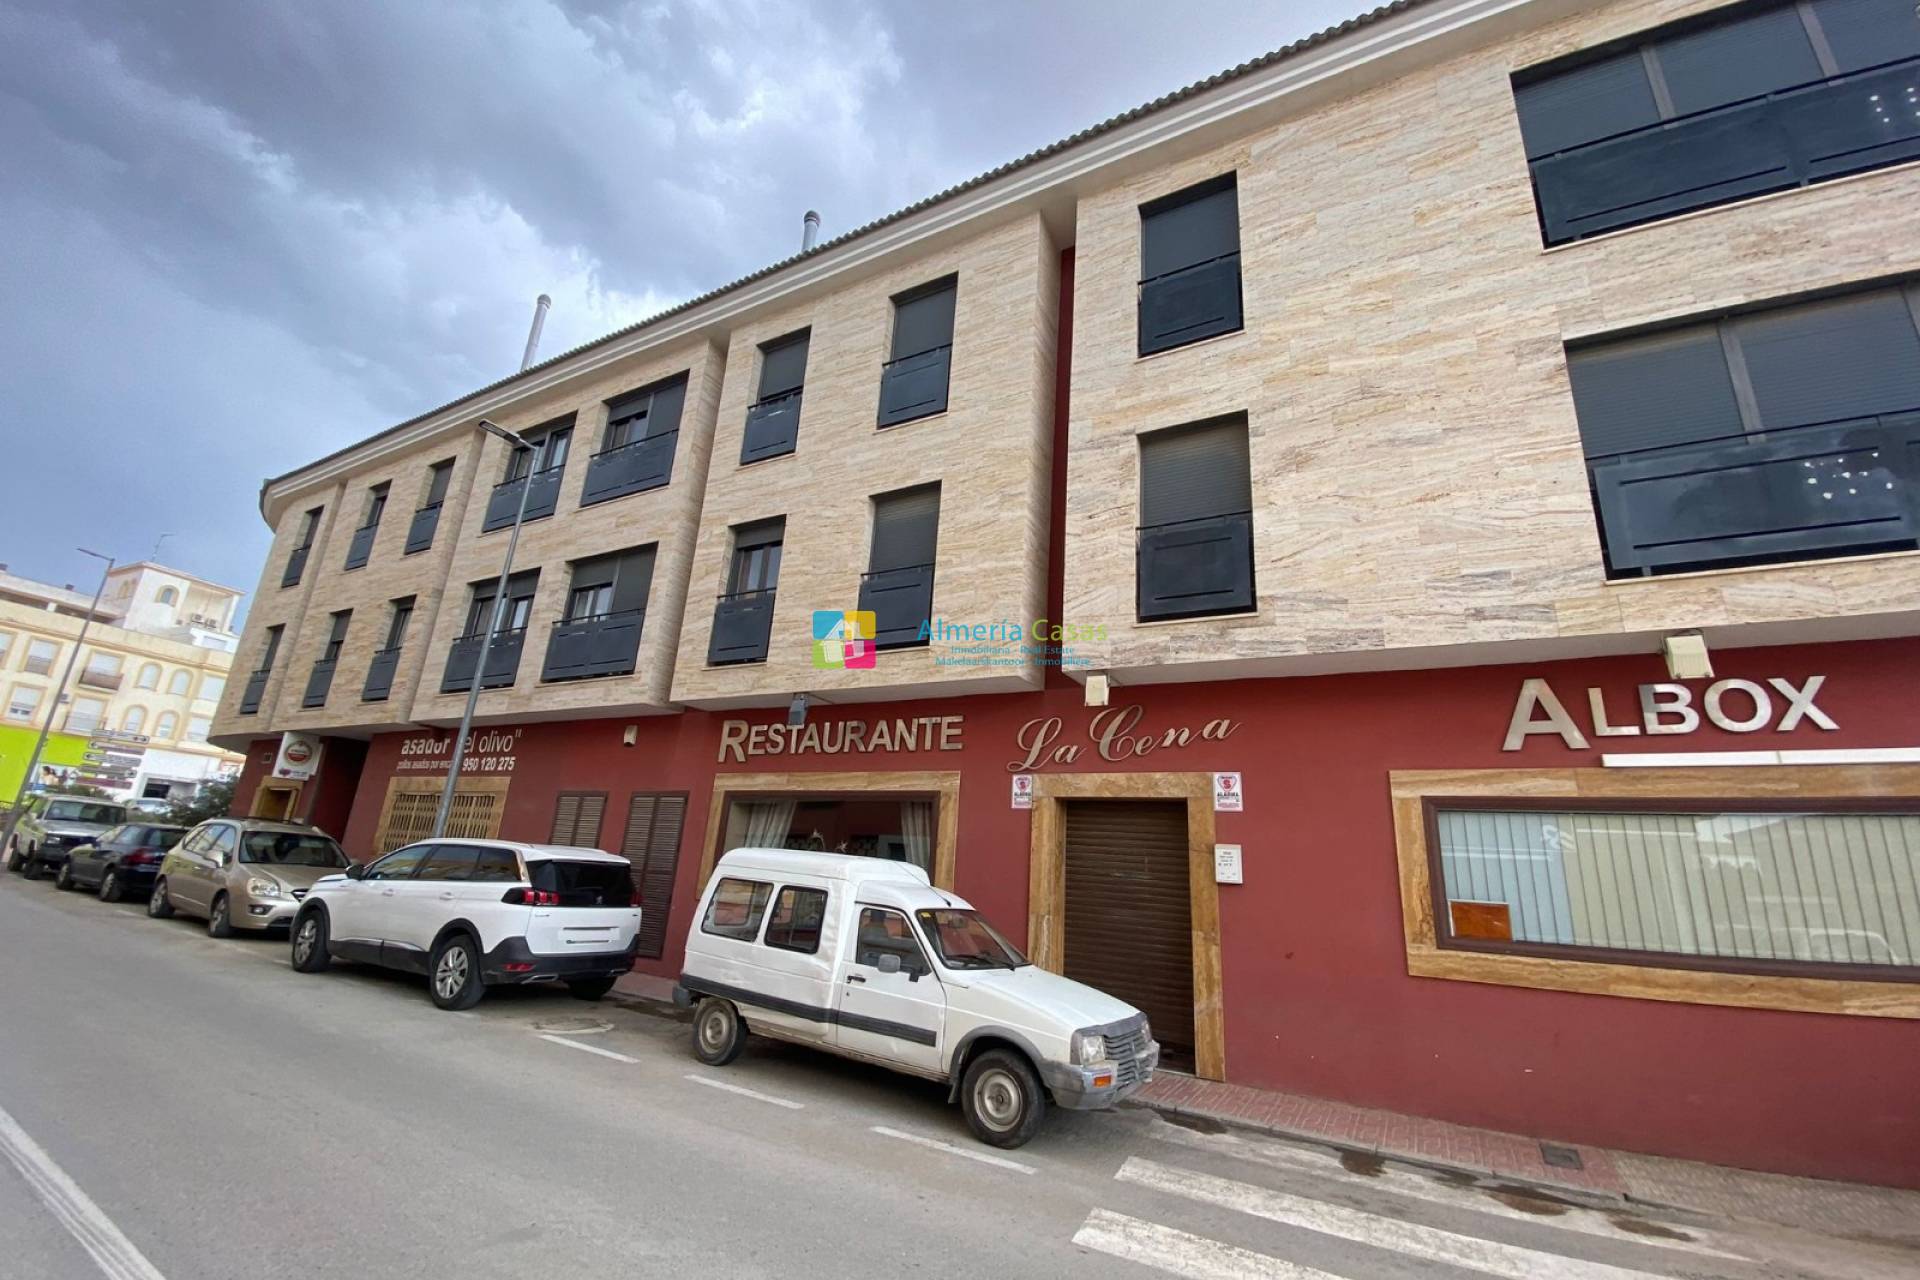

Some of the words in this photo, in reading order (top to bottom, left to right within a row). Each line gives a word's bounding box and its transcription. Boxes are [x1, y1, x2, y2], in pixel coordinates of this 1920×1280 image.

[1501, 675, 1840, 751] ALBOX
[401, 738, 451, 755] asador
[717, 715, 964, 763] RESTAURANTE
[1007, 717, 1086, 771] La
[1089, 705, 1242, 761] Cena
[462, 757, 479, 772] 950
[480, 757, 497, 772] 120
[497, 756, 516, 771] 275
